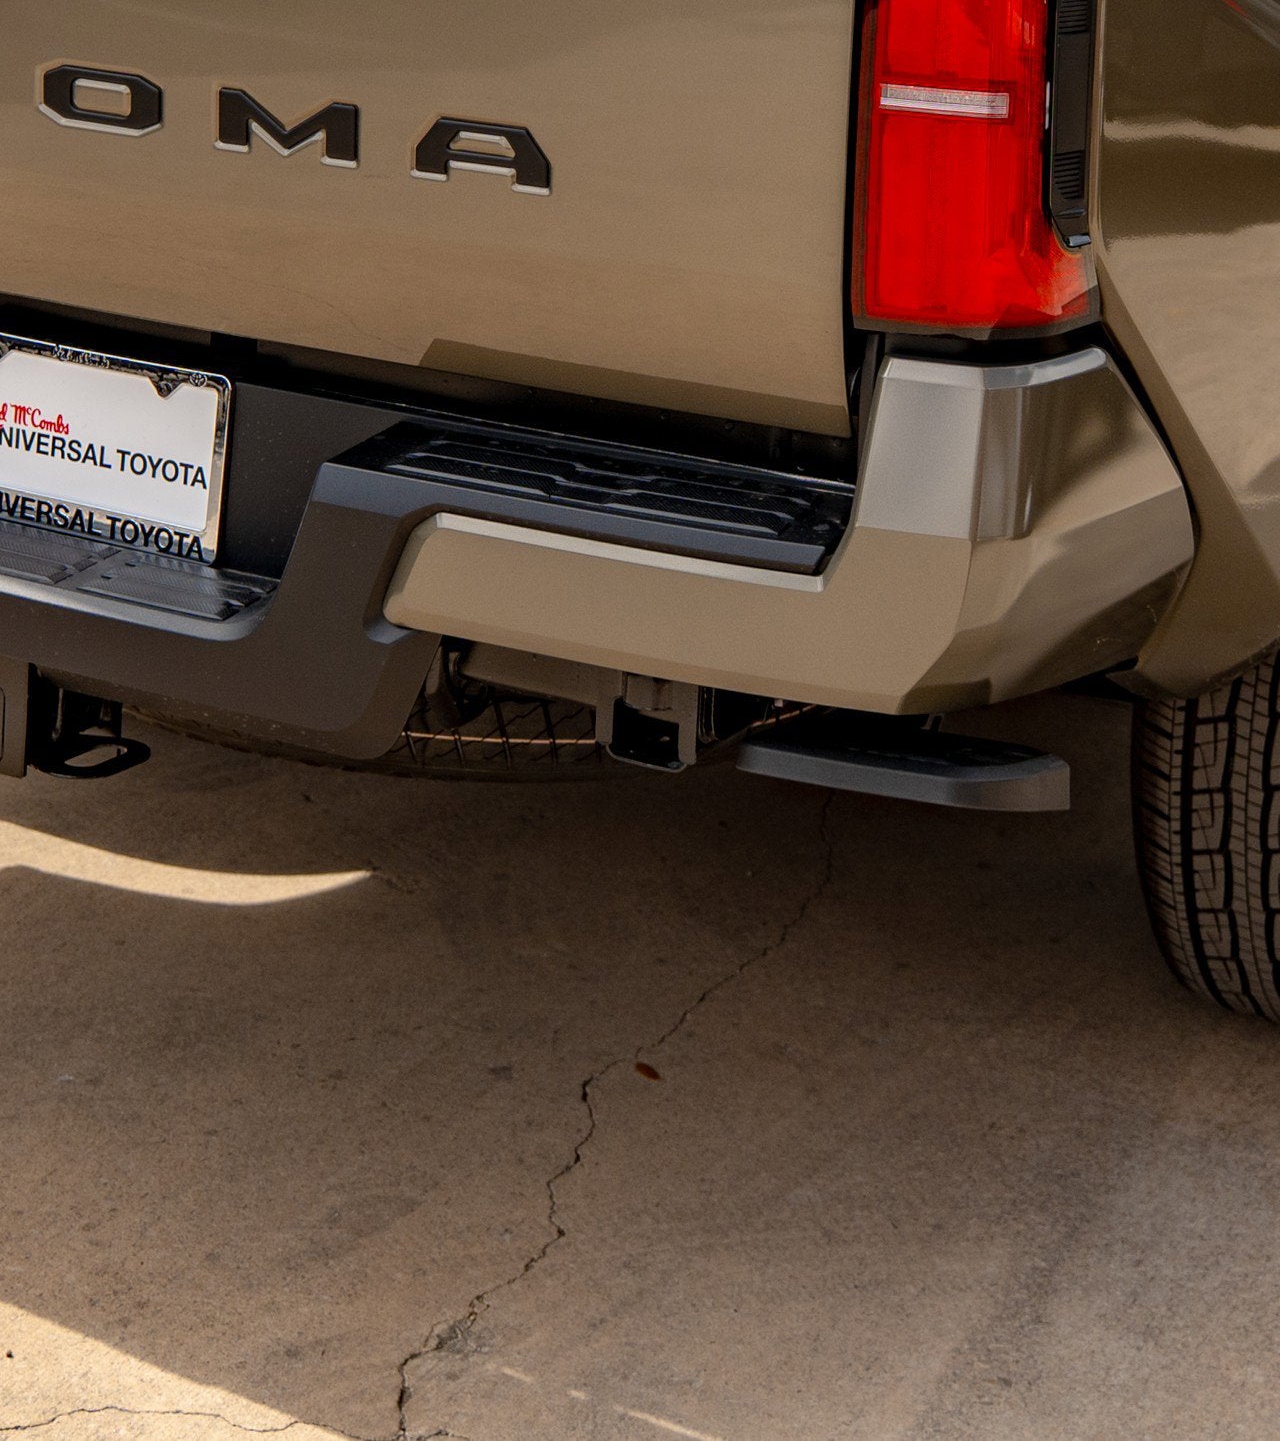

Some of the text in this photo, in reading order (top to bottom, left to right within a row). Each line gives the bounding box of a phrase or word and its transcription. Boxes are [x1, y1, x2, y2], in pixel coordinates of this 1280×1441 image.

[10, 404, 70, 435] McCombs
[116, 449, 208, 490] TOYOTA
[106, 515, 205, 560] TOYOTA
